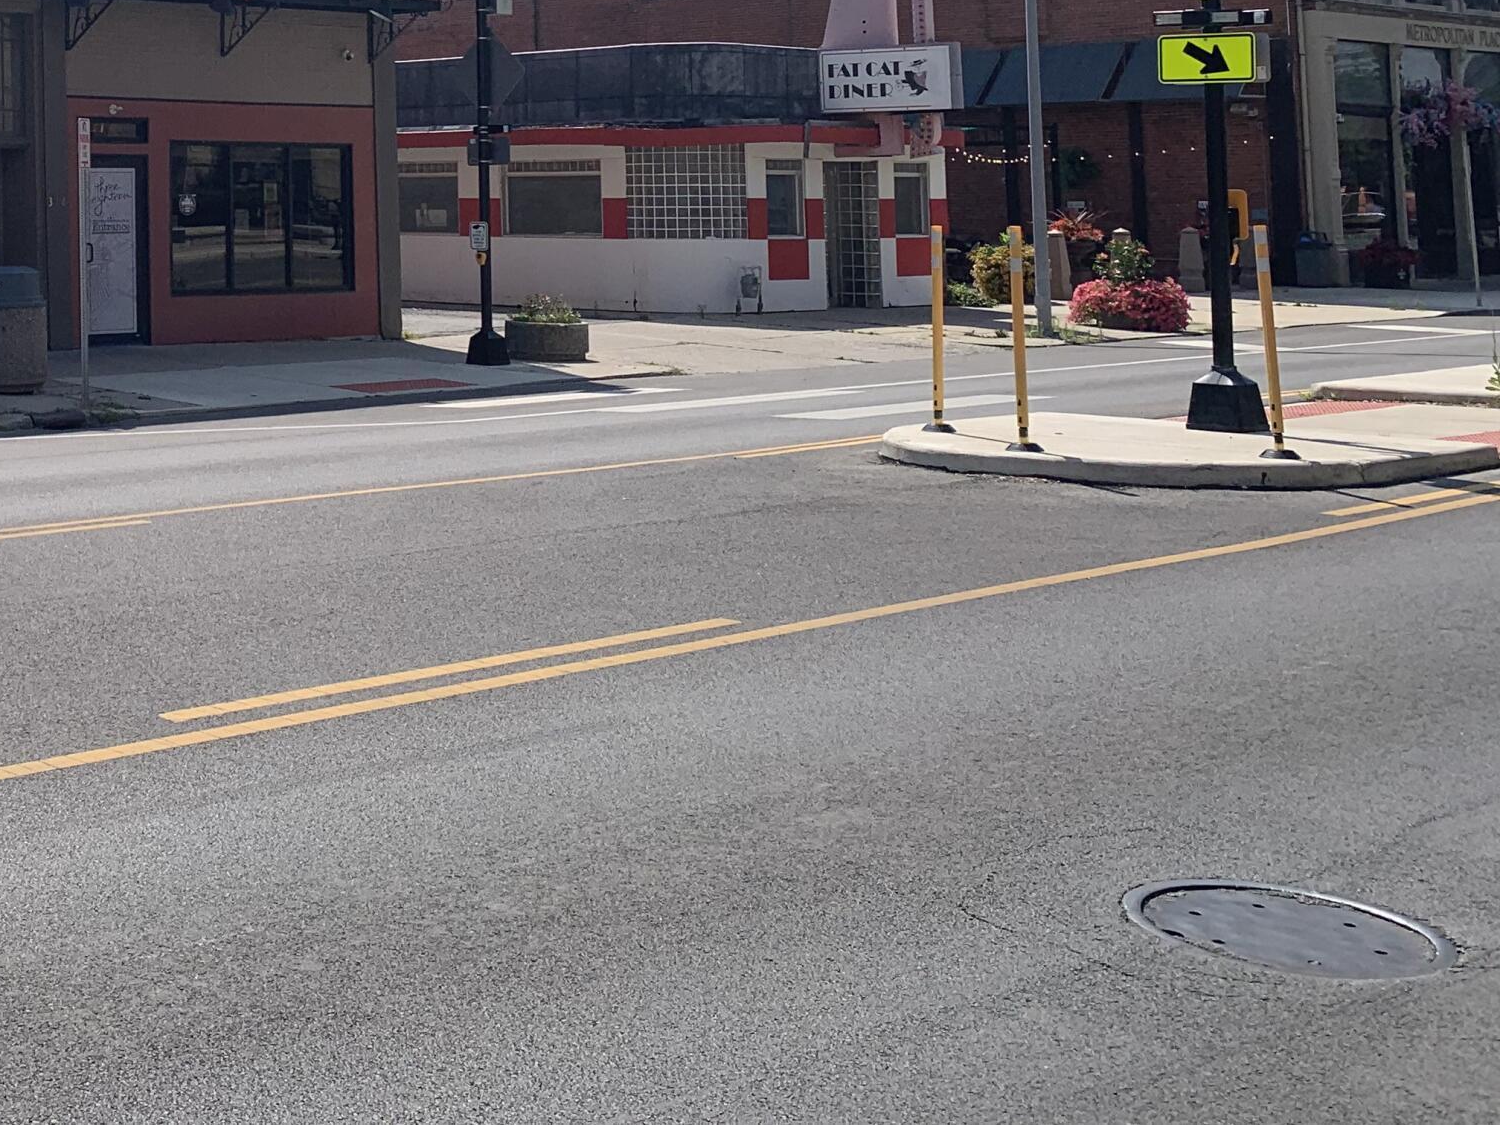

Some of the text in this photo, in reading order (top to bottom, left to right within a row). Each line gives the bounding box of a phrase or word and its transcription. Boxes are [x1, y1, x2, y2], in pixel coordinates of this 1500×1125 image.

[1406, 23, 1475, 45] METROPOLITAN
[827, 60, 902, 78] FAT CAT
[828, 82, 894, 99] DINER
